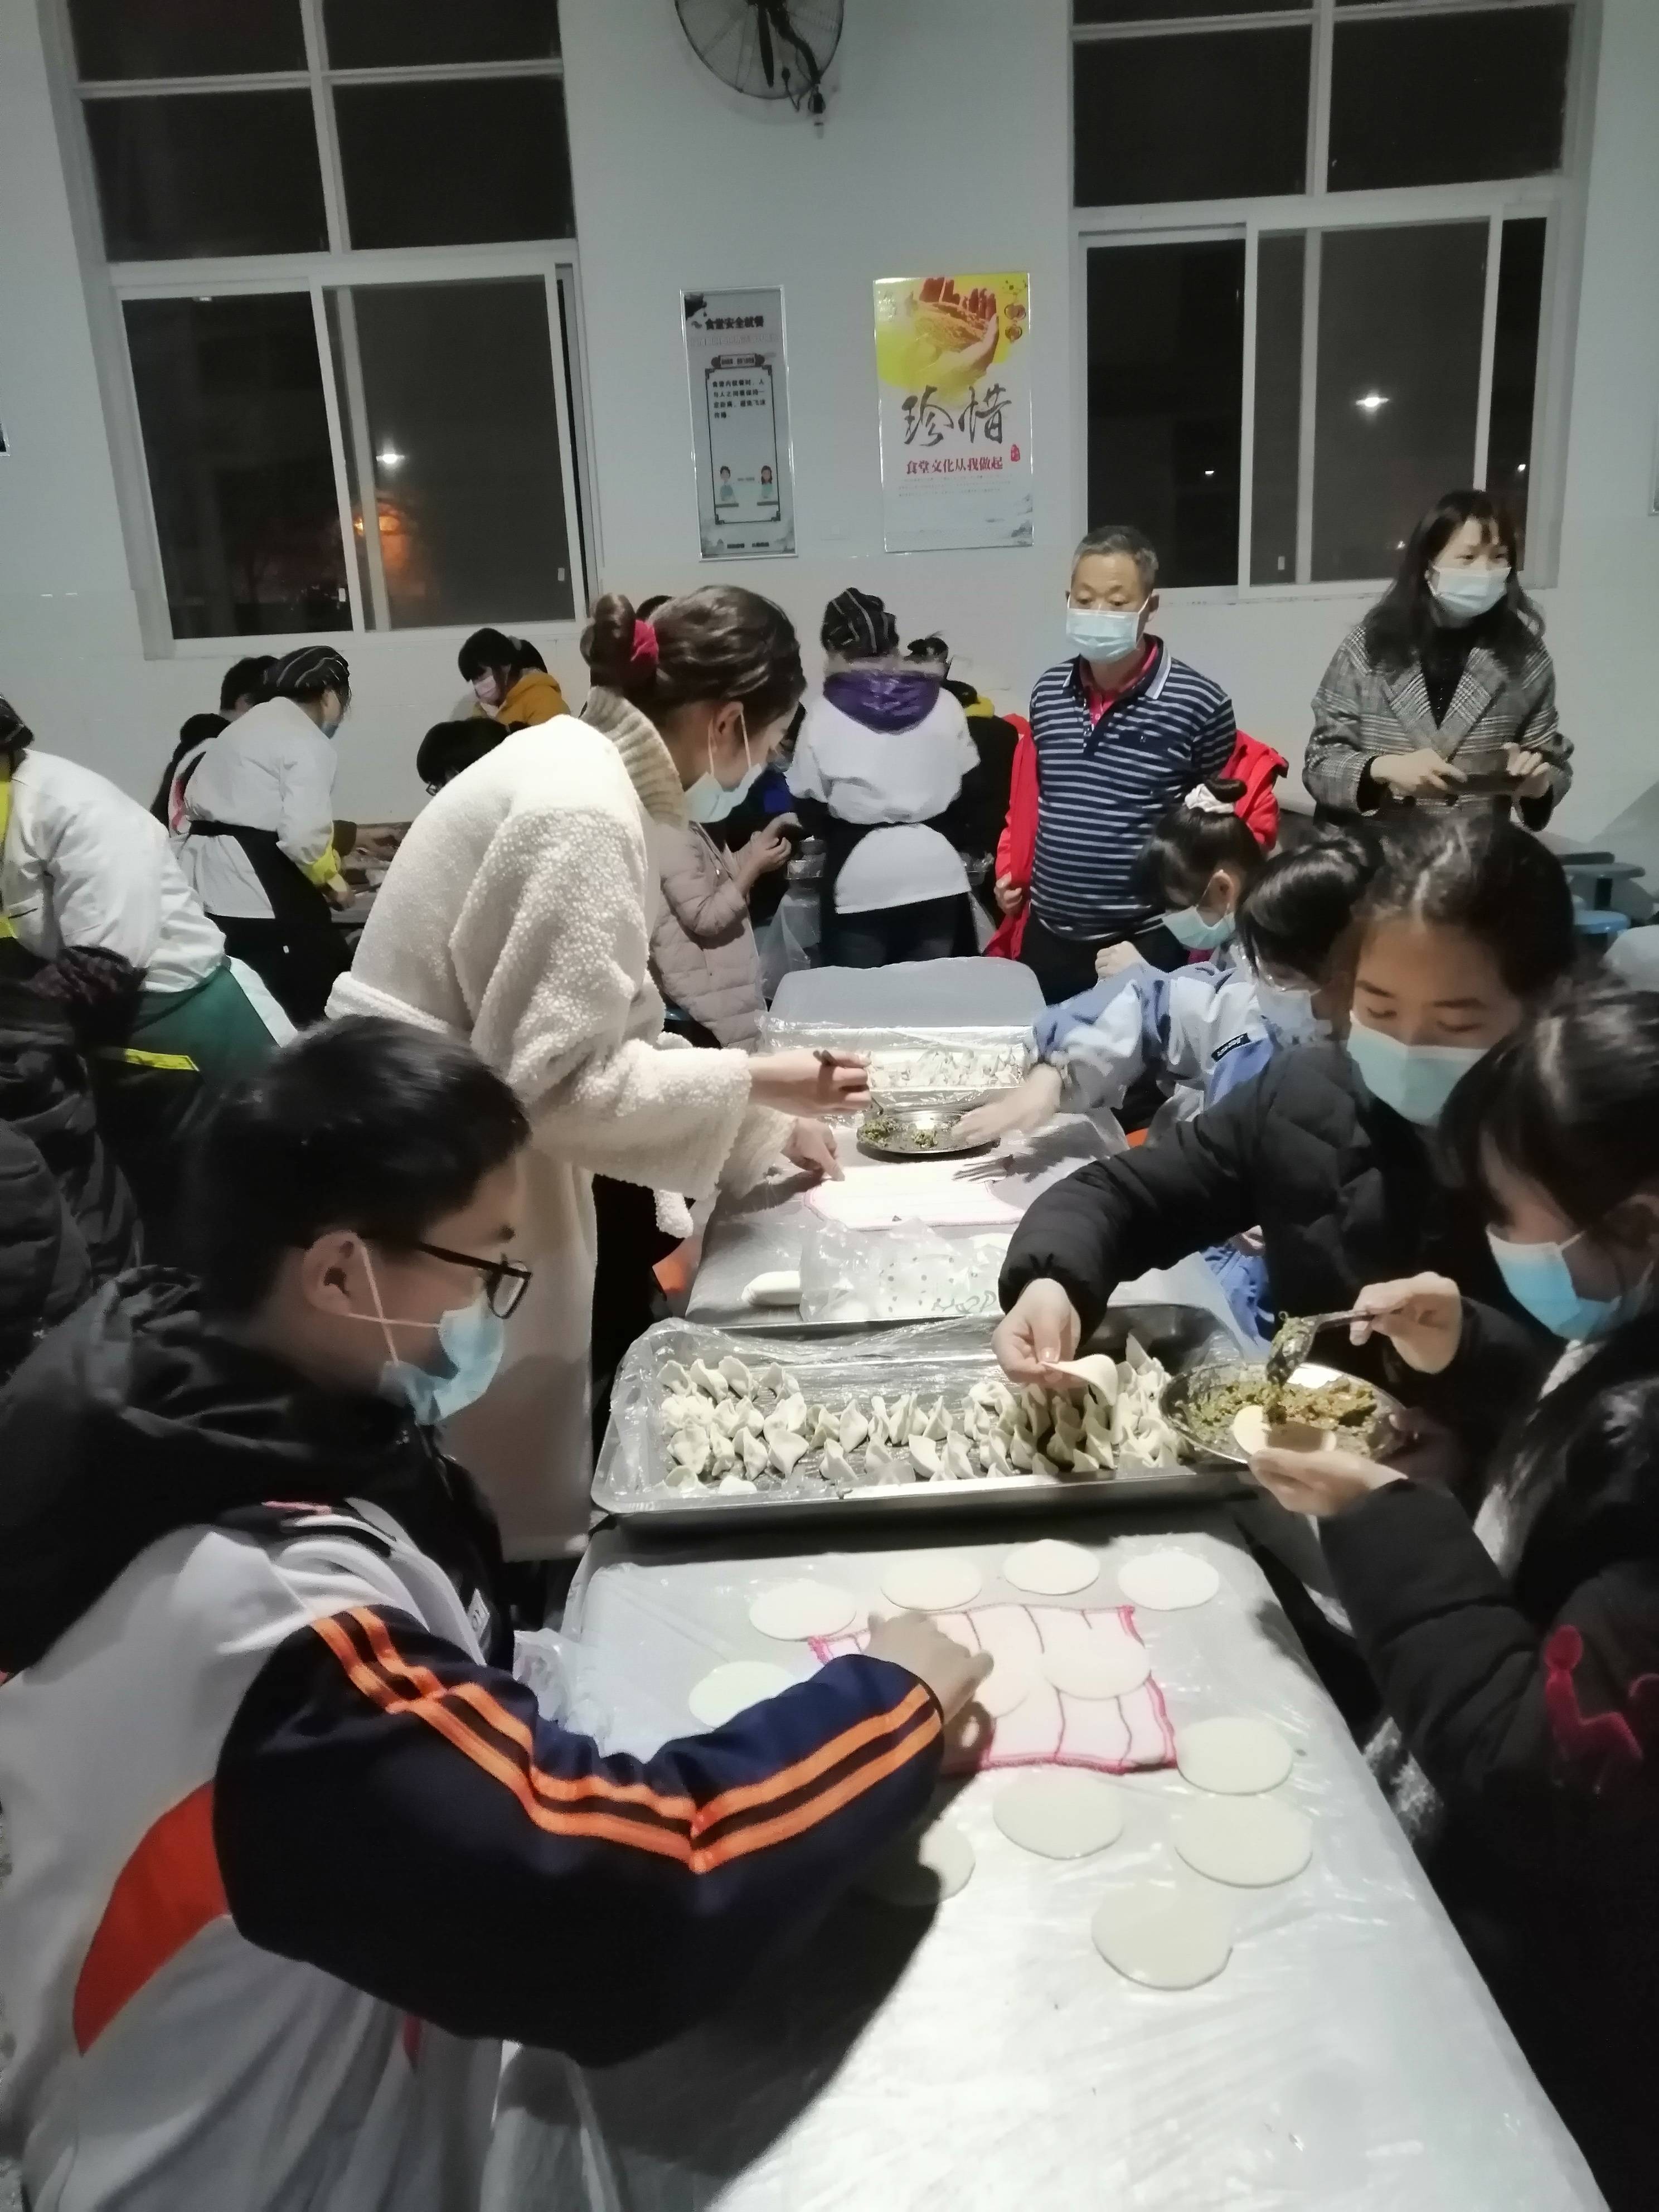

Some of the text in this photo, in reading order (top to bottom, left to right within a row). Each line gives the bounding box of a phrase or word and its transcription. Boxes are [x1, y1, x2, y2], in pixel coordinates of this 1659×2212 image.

[901, 383, 1012, 447] 珍惜
[906, 457, 1003, 474] 食堂文化从我做起
